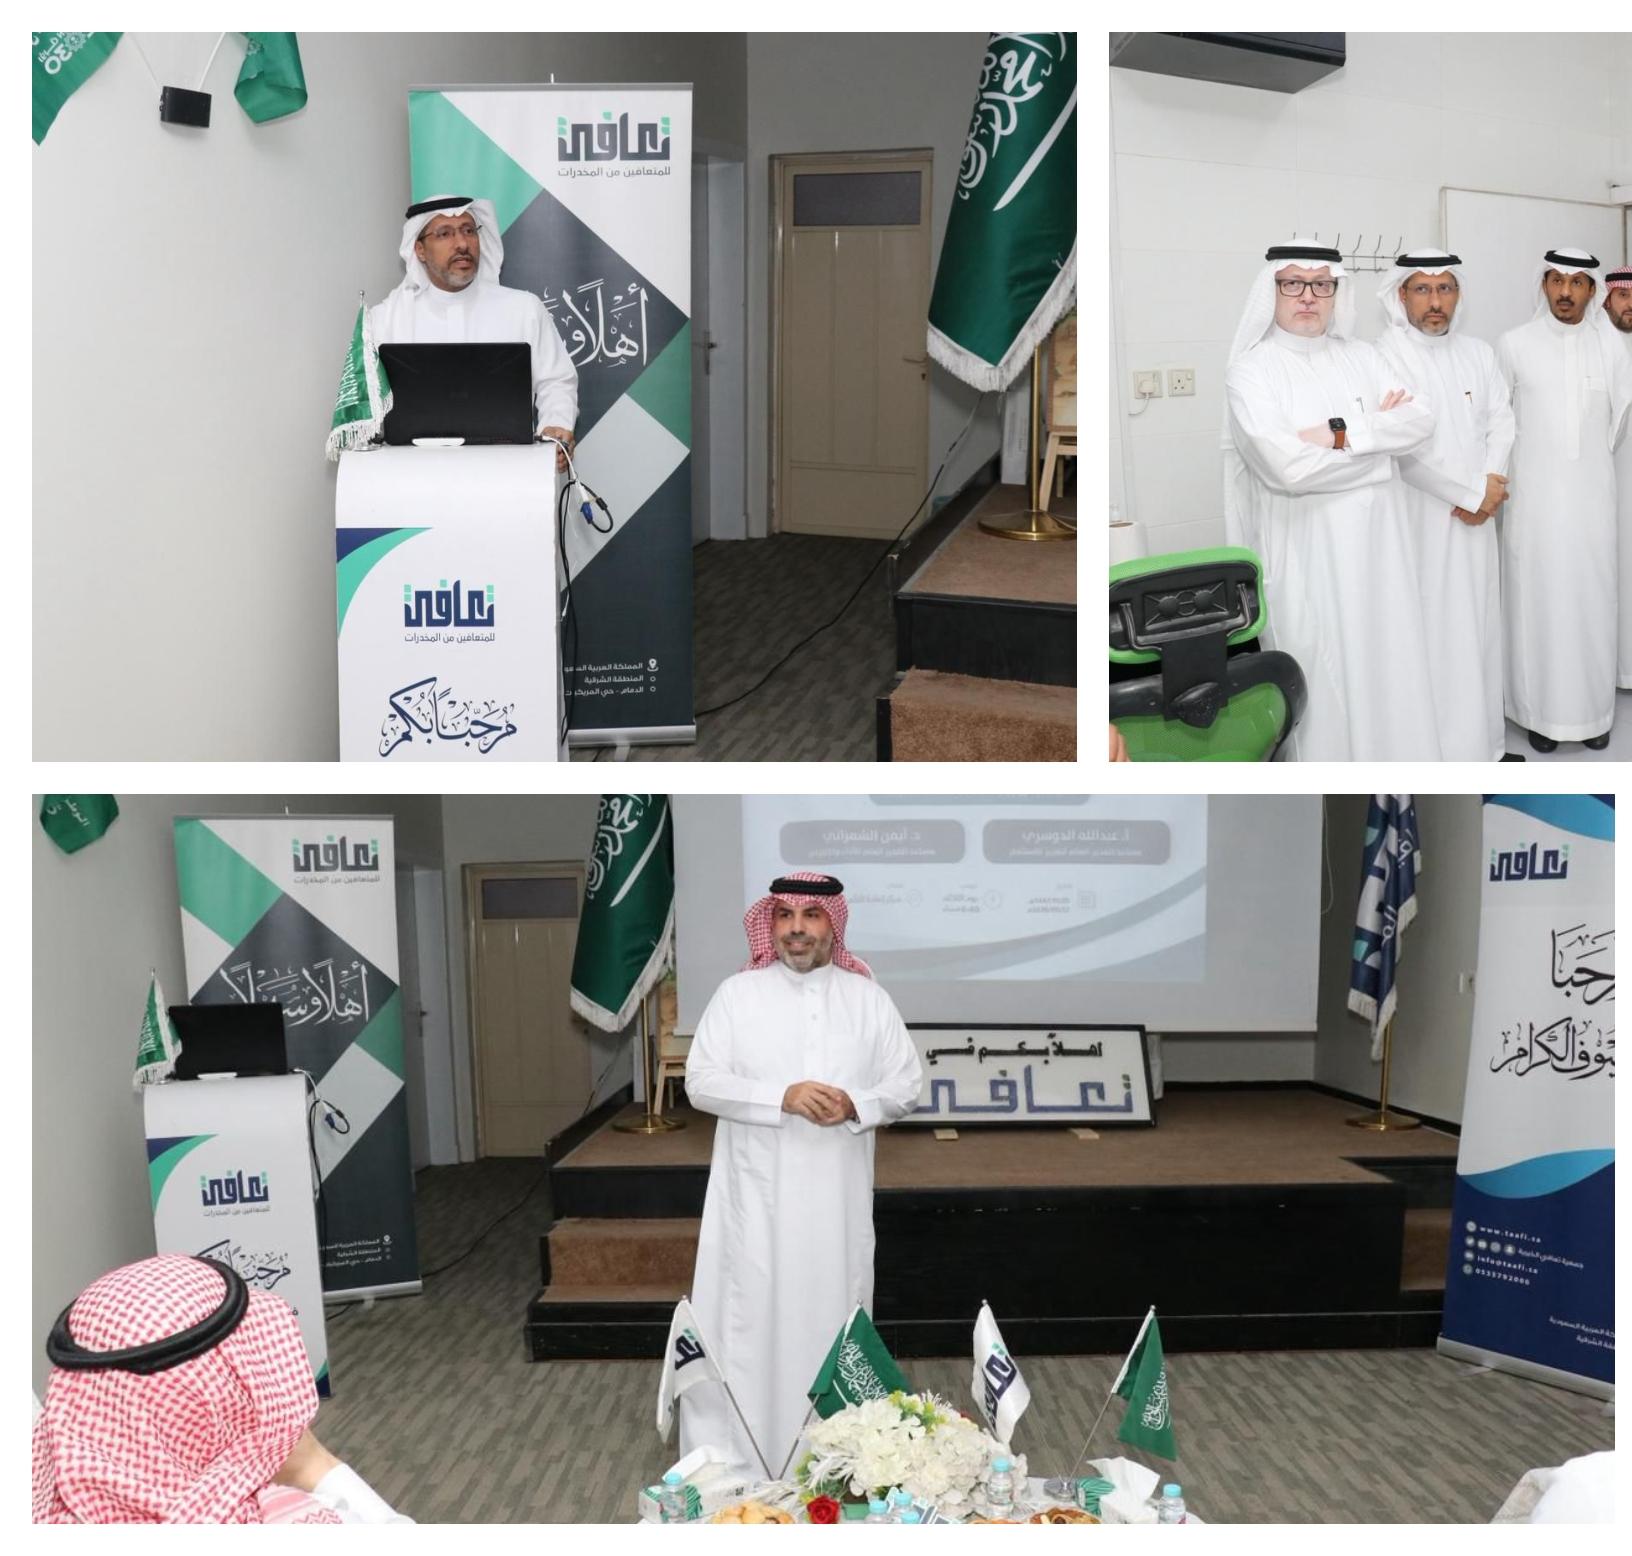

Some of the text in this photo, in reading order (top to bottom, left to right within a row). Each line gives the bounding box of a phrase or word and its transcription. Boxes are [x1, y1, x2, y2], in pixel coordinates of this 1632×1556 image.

[557, 111, 671, 162] تعافي
[558, 166, 671, 179] للمتعافين من المخدرات
[403, 579, 495, 628] تعافي
[404, 633, 496, 644] للمتعافين من المخدرات
[292, 835, 379, 873] تعافي
[1489, 842, 1569, 882] تعافي
[926, 1037, 975, 1066] في
[978, 1040, 1050, 1065] بكم
[200, 1169, 269, 1207] تعافي
